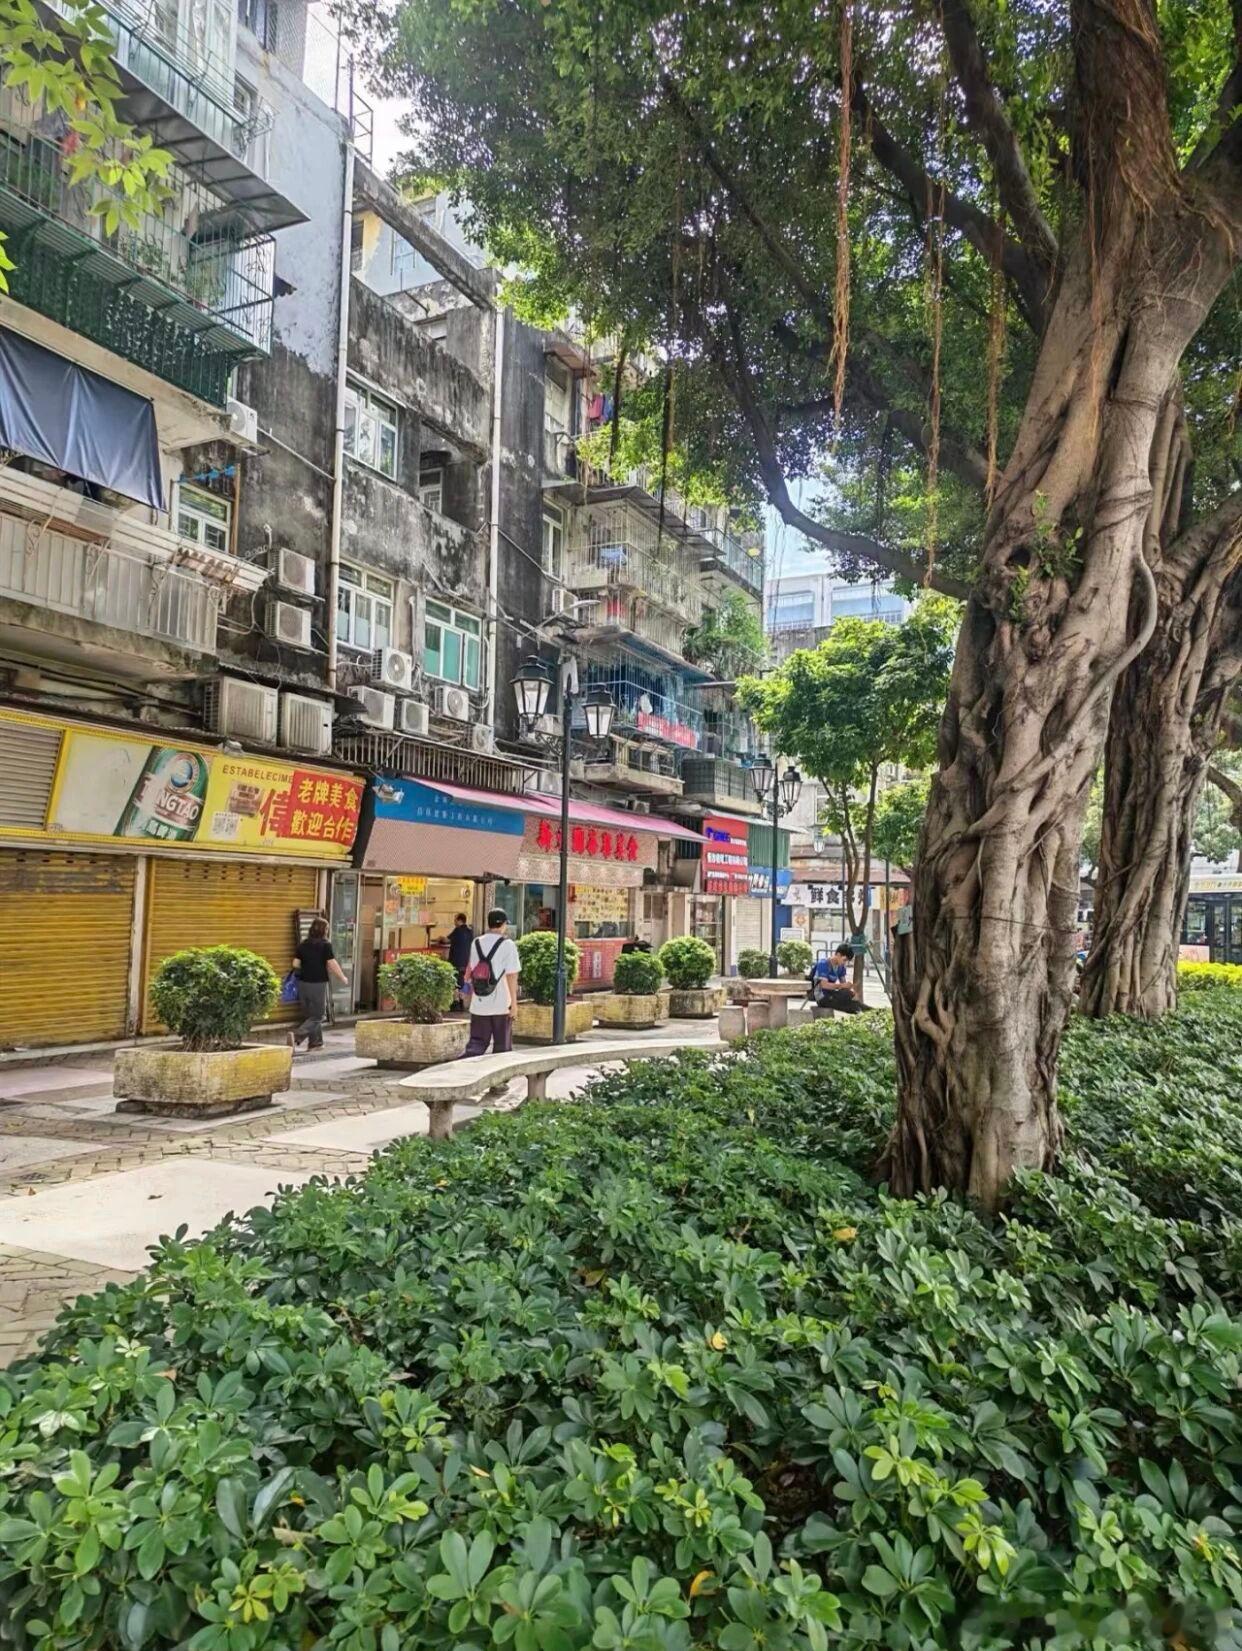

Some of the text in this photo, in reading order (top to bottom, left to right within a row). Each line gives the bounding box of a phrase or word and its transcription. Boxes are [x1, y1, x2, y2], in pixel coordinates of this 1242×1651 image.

[298, 778, 359, 812] 老牌美食
[290, 809, 354, 840] 歡迎合作
